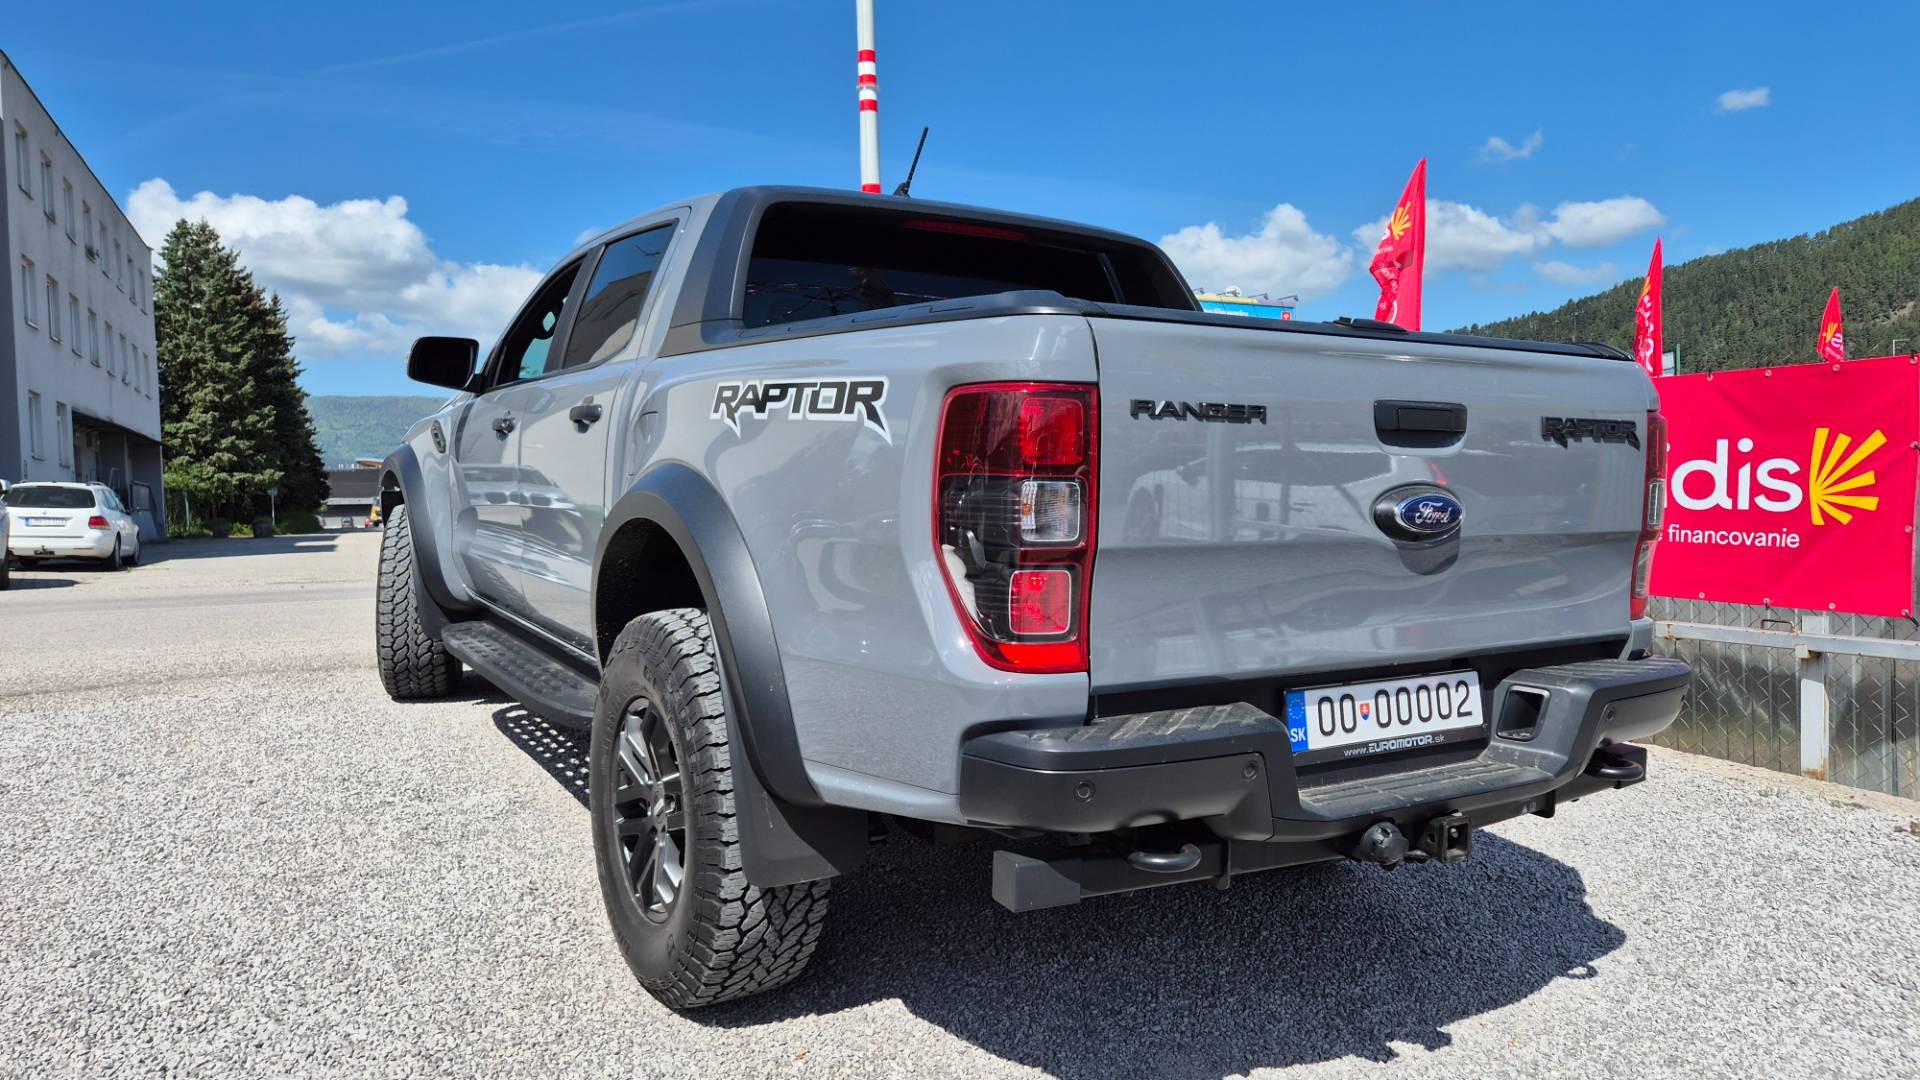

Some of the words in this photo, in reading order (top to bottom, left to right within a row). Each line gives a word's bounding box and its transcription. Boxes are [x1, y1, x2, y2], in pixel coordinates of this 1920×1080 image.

[709, 376, 894, 447] RAPTOR
[1130, 399, 1267, 424] RANGER
[1541, 416, 1640, 451] RAPTOR
[1664, 437, 1803, 513] dis
[1415, 501, 1452, 524] Ford
[1667, 523, 1801, 549] financovanie
[1290, 727, 1306, 742] SK
[1343, 733, 1446, 757] www.EUROMOTOR.sk
